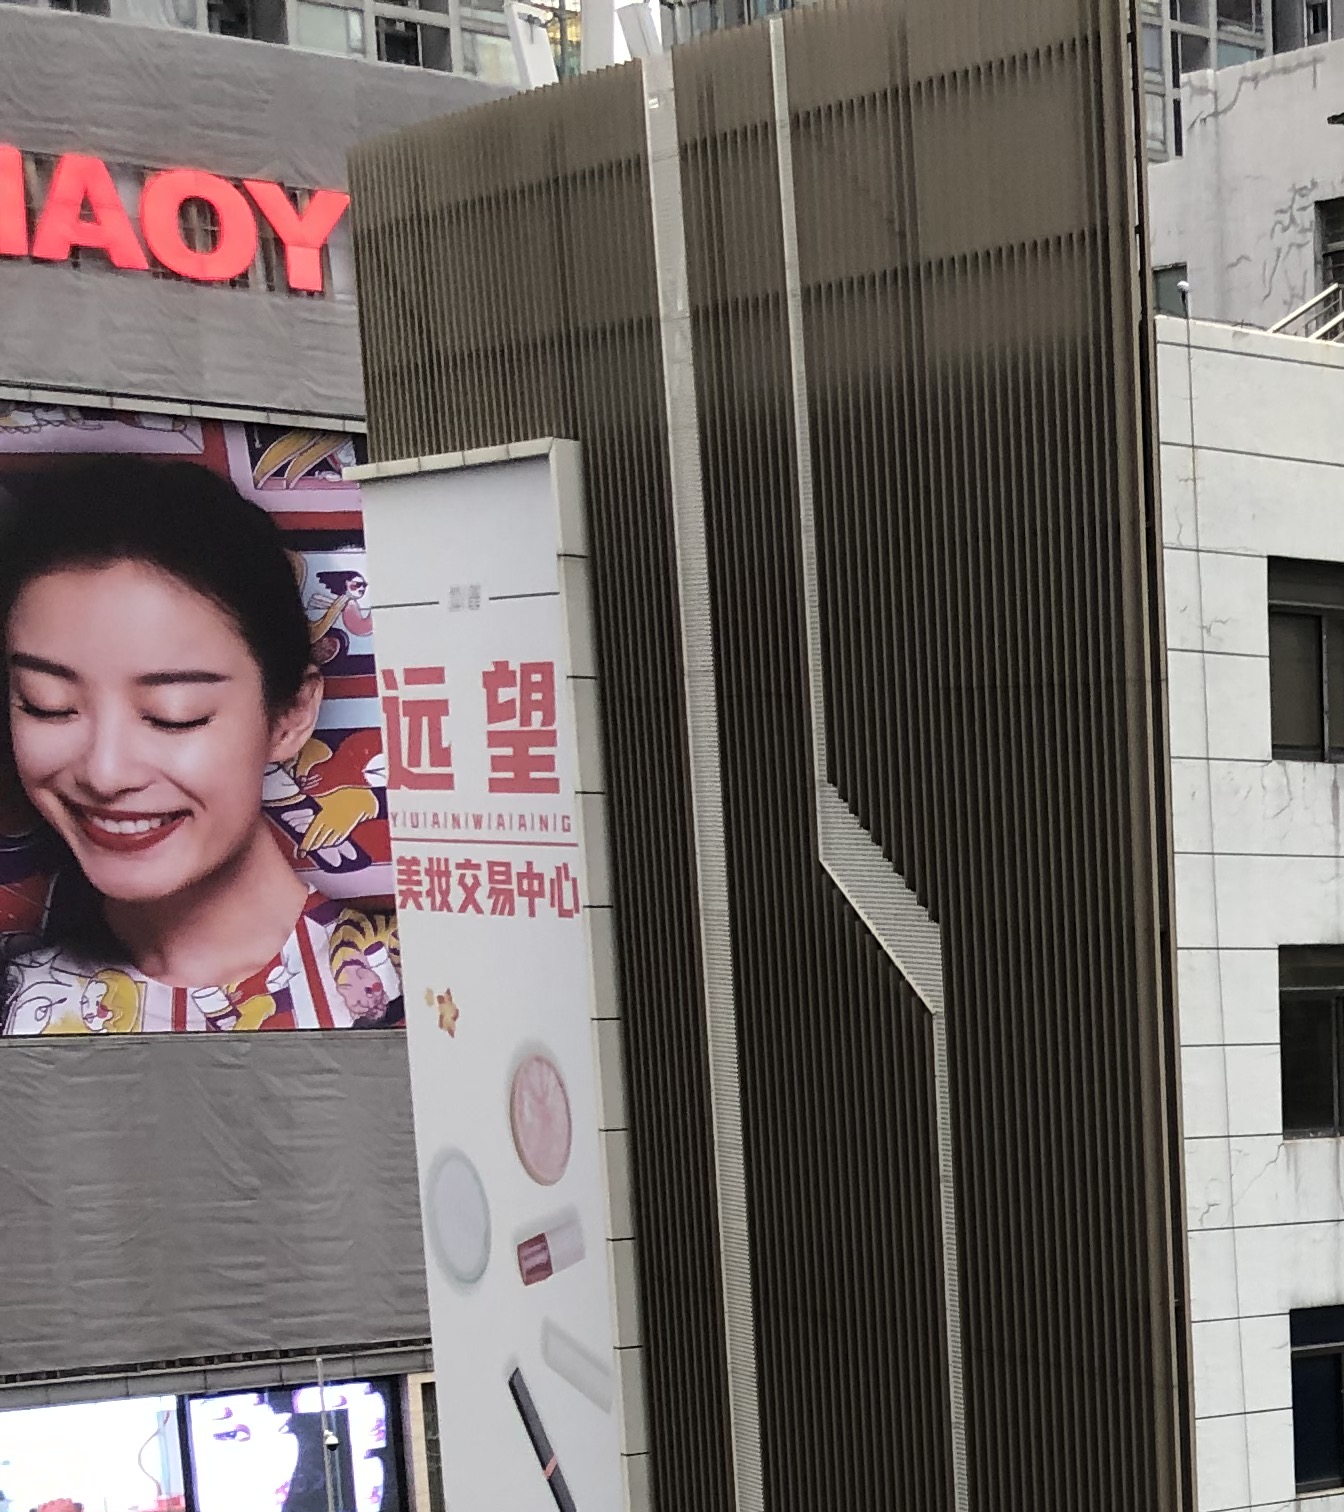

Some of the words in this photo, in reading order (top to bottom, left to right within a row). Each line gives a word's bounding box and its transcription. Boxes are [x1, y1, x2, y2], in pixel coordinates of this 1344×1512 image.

[381, 660, 560, 794] 远望
[396, 855, 580, 919] 美妆交易中心
